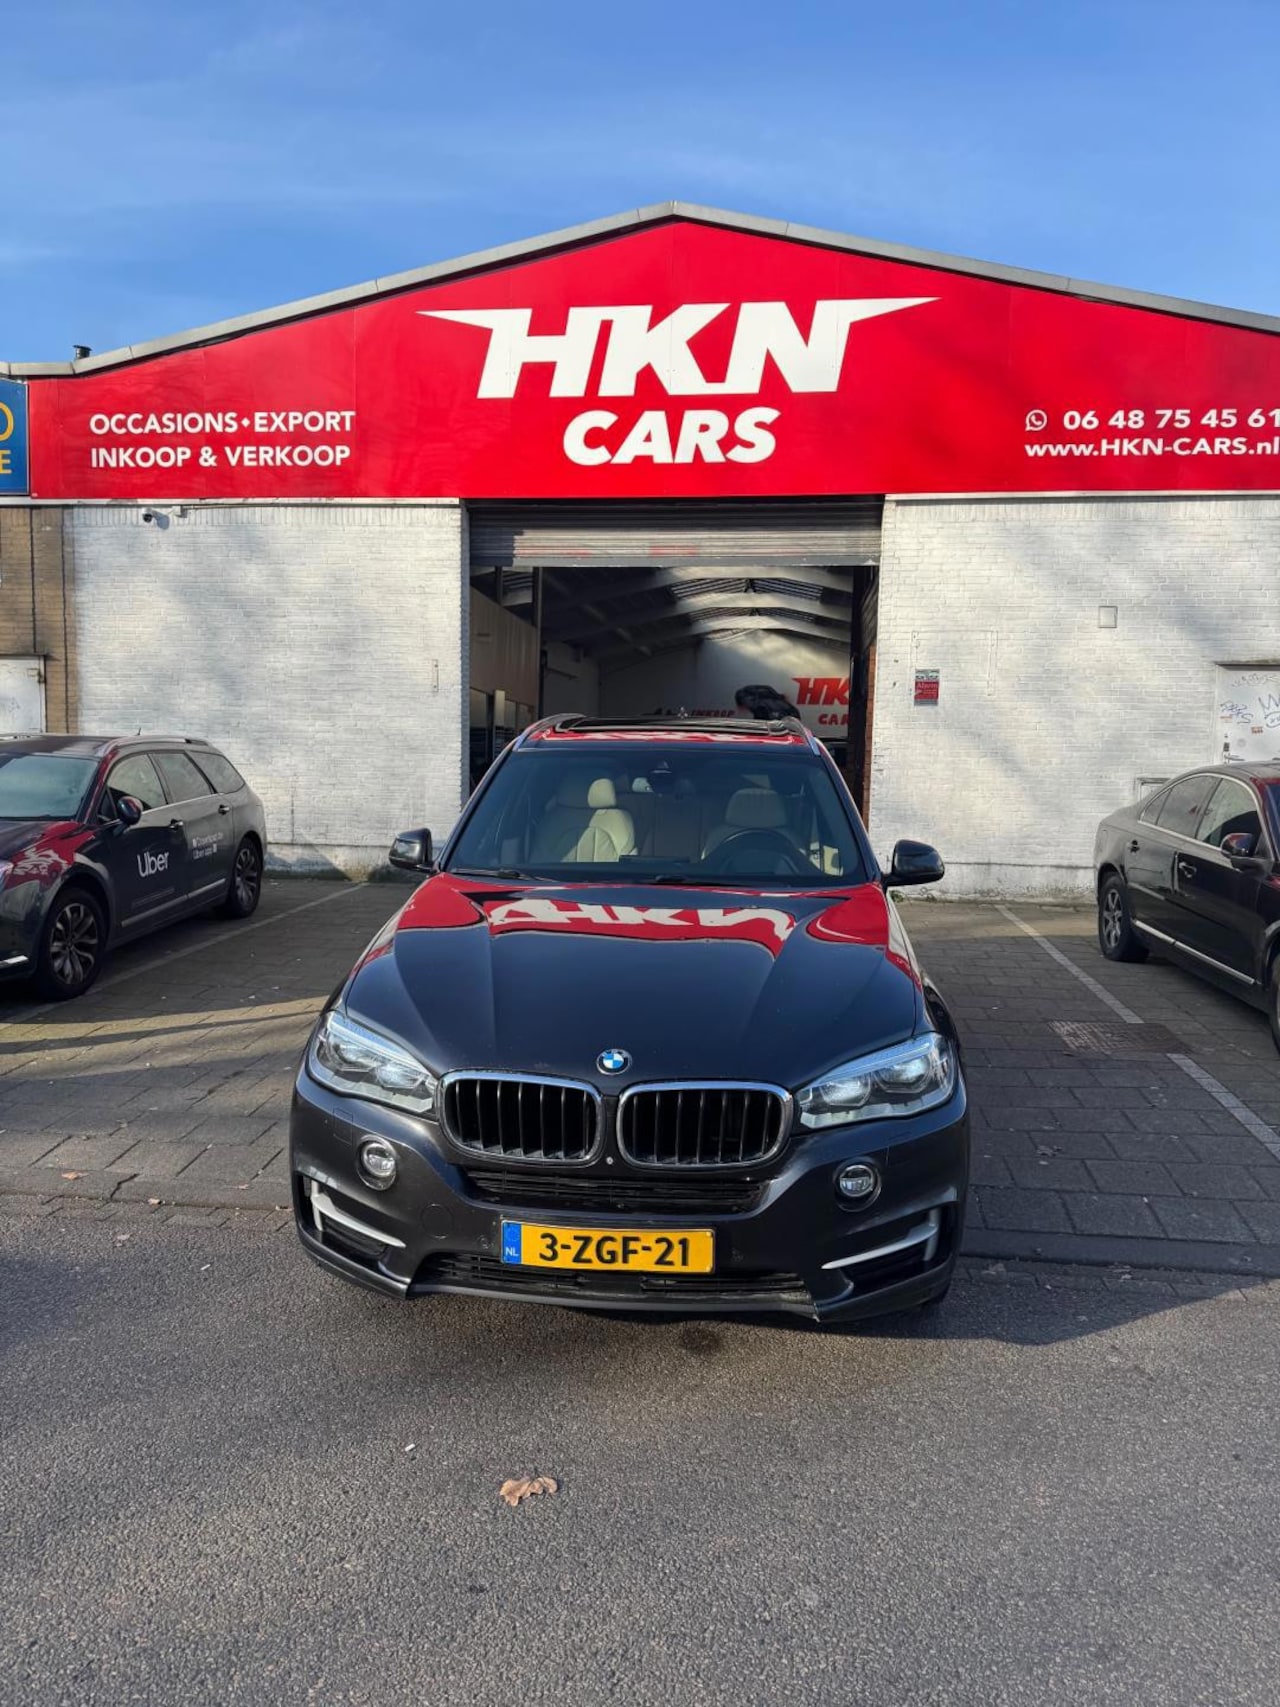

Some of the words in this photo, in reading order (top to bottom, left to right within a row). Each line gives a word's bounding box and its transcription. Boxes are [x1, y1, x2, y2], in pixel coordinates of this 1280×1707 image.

[415, 297, 940, 399] HKN
[89, 412, 239, 435] OCCASIONS
[253, 411, 356, 433] EXPORT
[1063, 410, 1100, 430] 06
[1108, 409, 1145, 429] 48
[1155, 409, 1191, 429] 75
[1200, 408, 1238, 428] 45
[563, 407, 780, 466] CARS
[1024, 437, 1280, 456] www.HKN-CARS.nl
[91, 446, 192, 468] INKOOP
[198, 446, 218, 467] &
[224, 445, 351, 467] VERKOOP
[137, 851, 169, 877] Uber
[505, 1246, 519, 1257] NL
[539, 1232, 690, 1267] 3-ZGF-21
